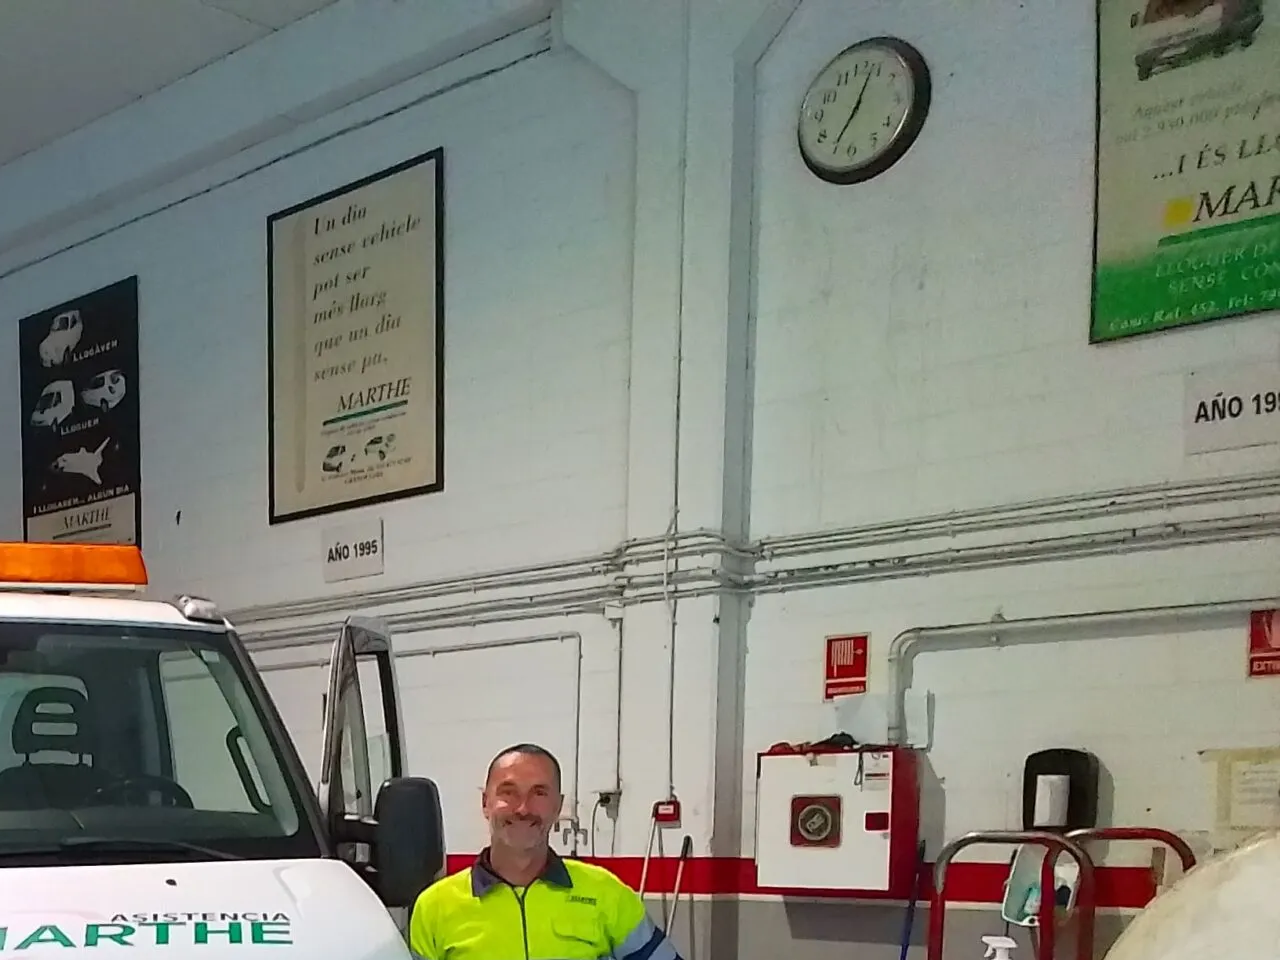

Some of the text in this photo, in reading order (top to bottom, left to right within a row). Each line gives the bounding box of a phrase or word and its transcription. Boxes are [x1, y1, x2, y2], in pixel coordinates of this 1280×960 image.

[1238, 134, 1280, 159] LL
[313, 214, 421, 266] sense vehicle
[312, 266, 371, 301] pot ser
[313, 290, 387, 325] més llarg
[313, 334, 342, 357] que
[348, 326, 369, 343] un
[313, 360, 356, 383] sense
[337, 377, 412, 412] MARTHE
[1194, 391, 1280, 424] AÑO 19
[327, 539, 378, 563] AÑO 1995
[111, 912, 290, 923] ASISTENCIA
